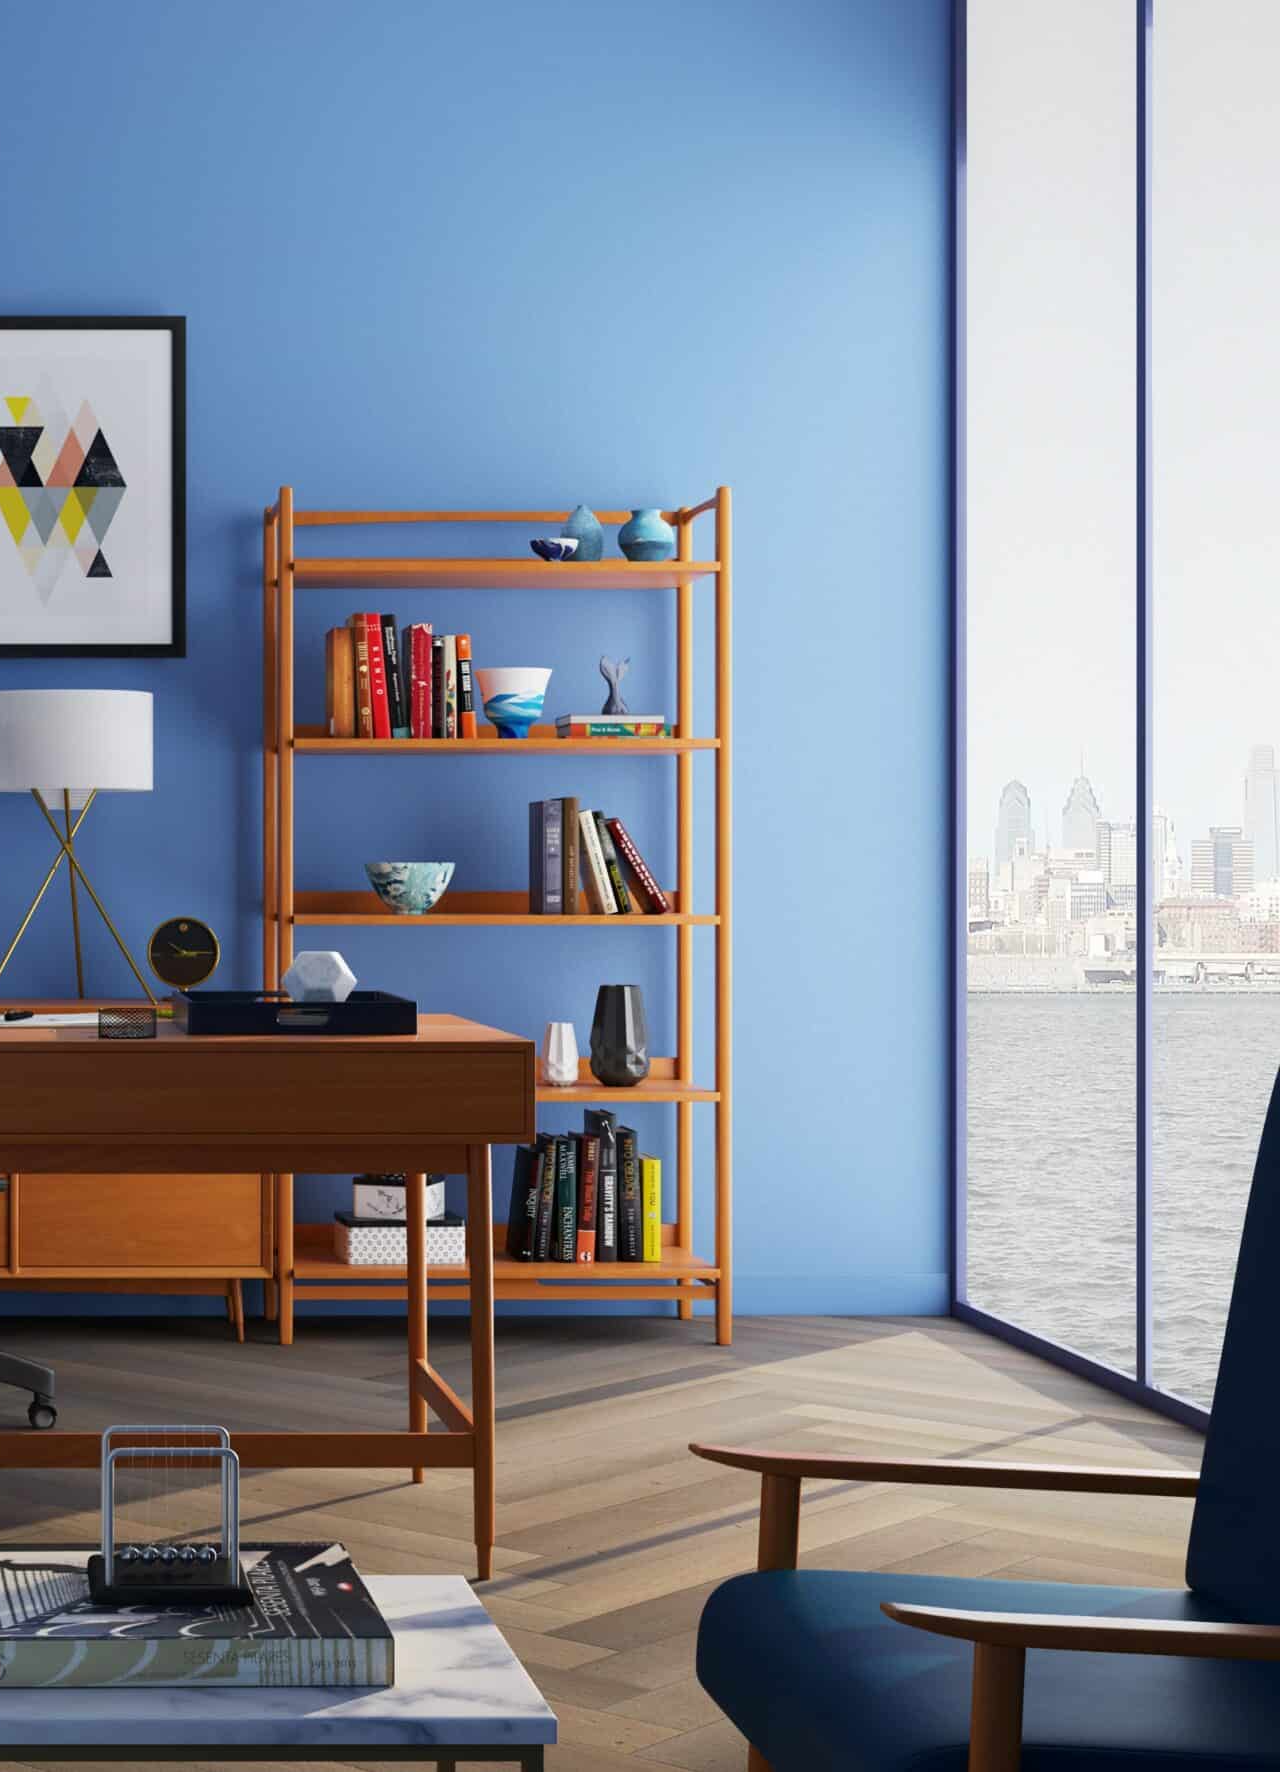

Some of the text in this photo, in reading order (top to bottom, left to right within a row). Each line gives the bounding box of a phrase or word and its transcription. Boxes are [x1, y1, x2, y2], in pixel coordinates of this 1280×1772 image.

[559, 1144, 568, 1181] MAXWELL
[604, 1175, 614, 1211] GRAVITY'S
[562, 1206, 574, 1260] ENCHANTRESS
